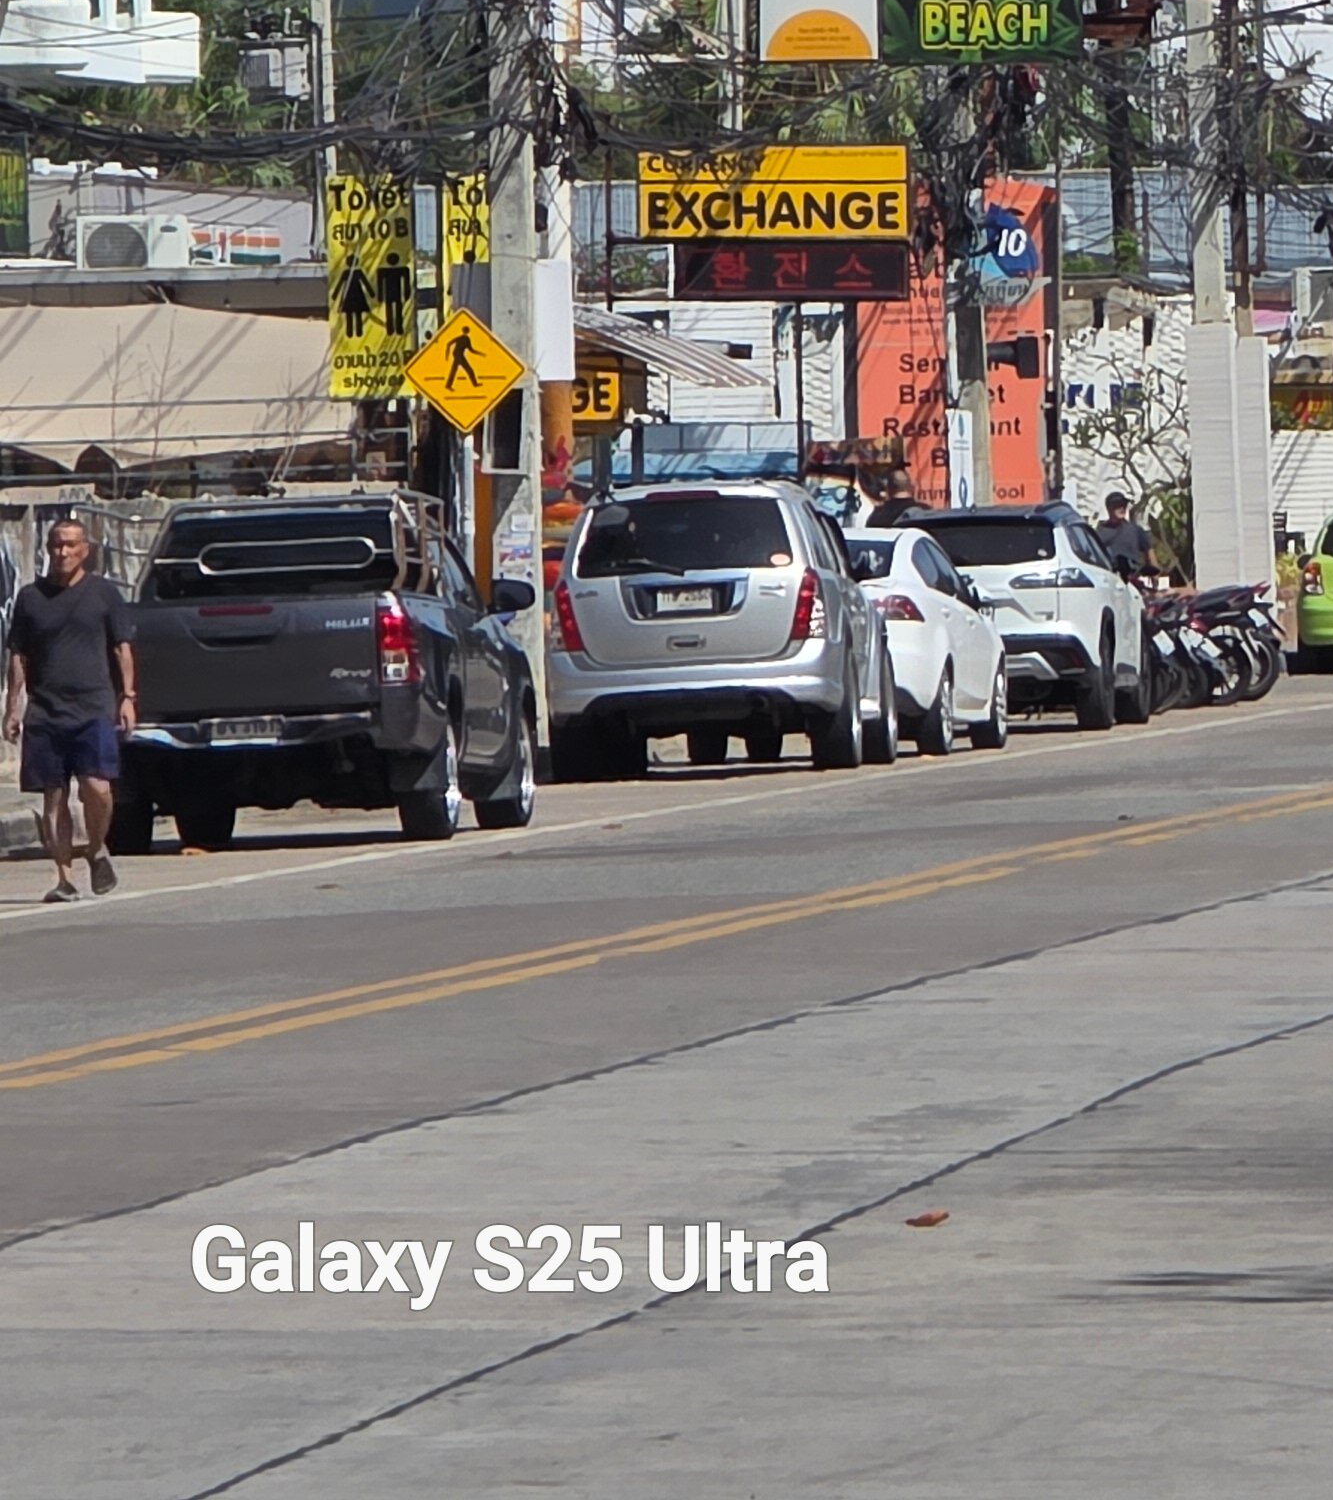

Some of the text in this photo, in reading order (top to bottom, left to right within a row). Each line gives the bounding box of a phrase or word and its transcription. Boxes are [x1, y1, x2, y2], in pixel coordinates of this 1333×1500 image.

[924, 1, 1048, 47] BEACH
[647, 190, 901, 231] EXCHANGE
[998, 228, 1027, 257] 10
